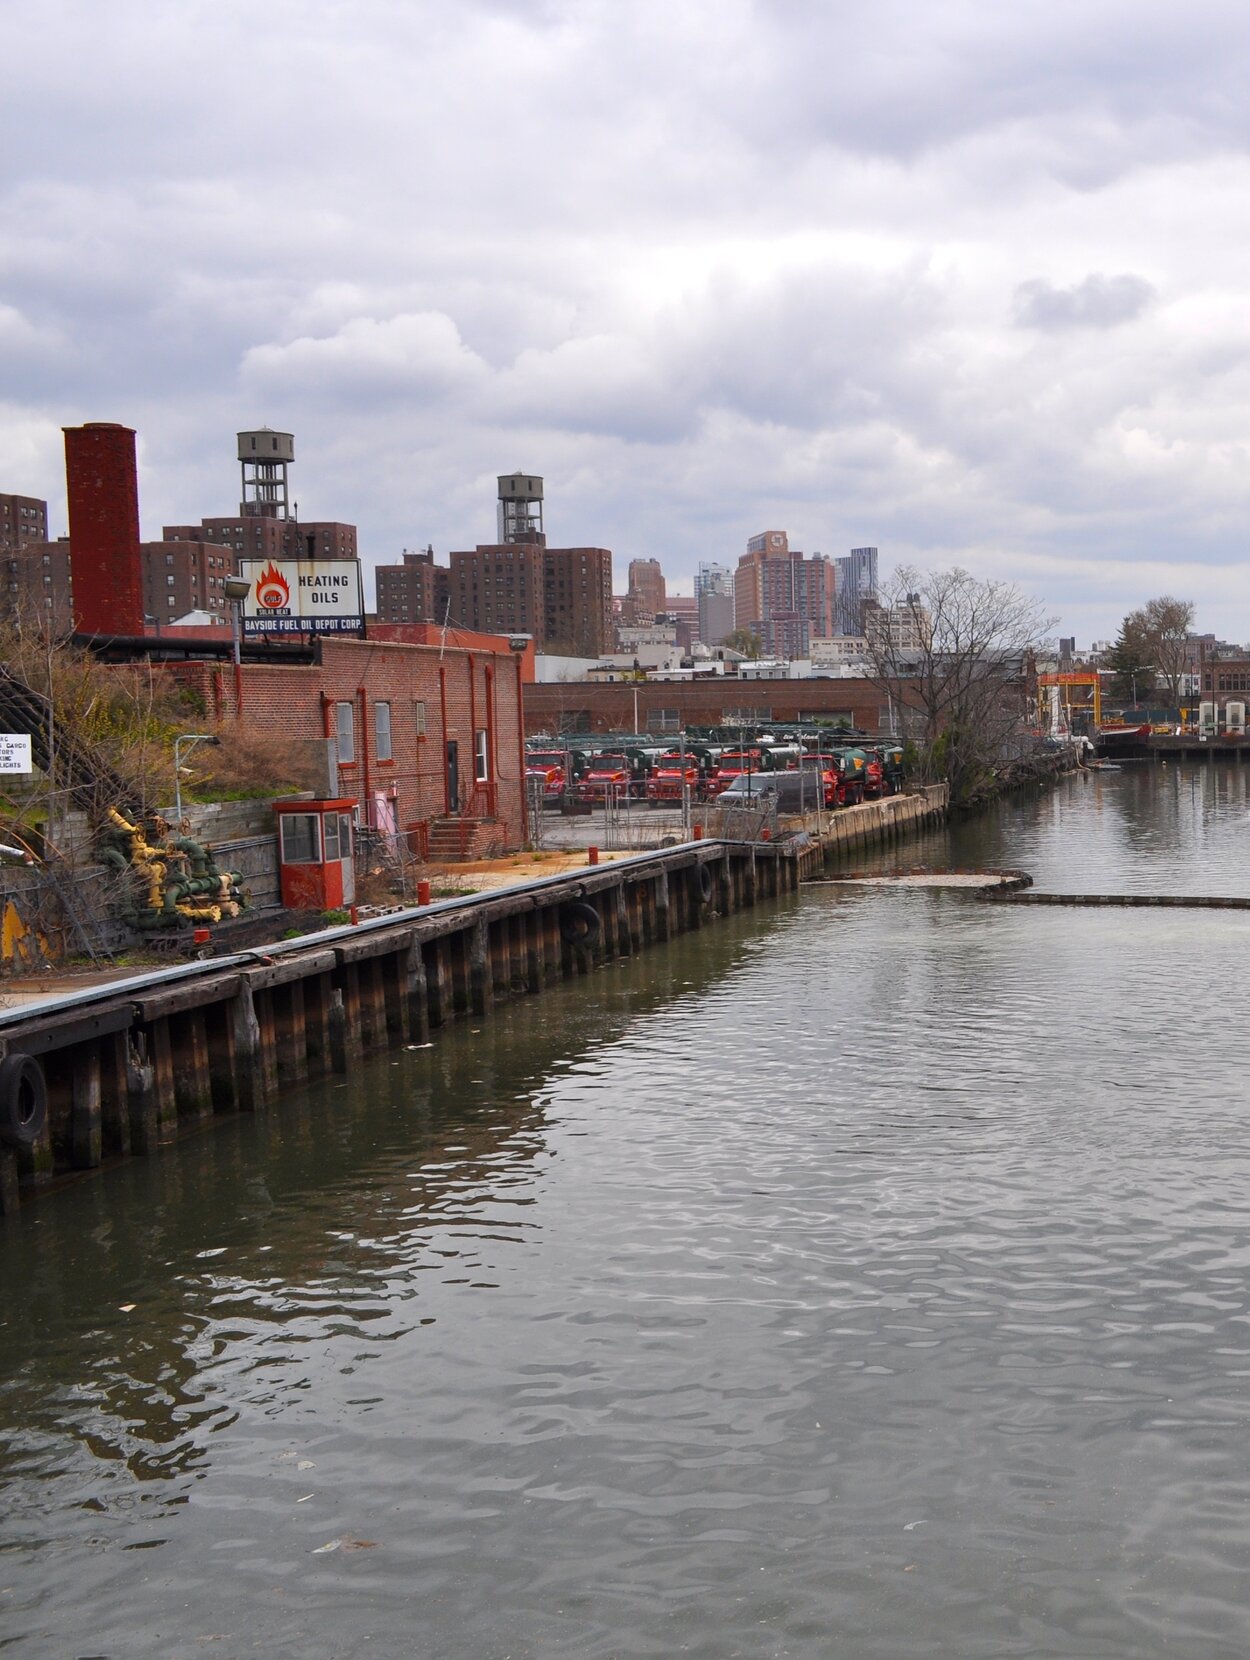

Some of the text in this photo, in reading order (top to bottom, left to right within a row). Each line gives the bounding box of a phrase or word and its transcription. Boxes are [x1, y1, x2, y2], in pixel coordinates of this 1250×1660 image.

[299, 576, 348, 586] HEATING
[311, 592, 338, 603] OILS
[258, 608, 289, 616] SOLAR HEAT
[245, 618, 362, 630] BAYSIDE FUEL OIL DEPOT CORP.
